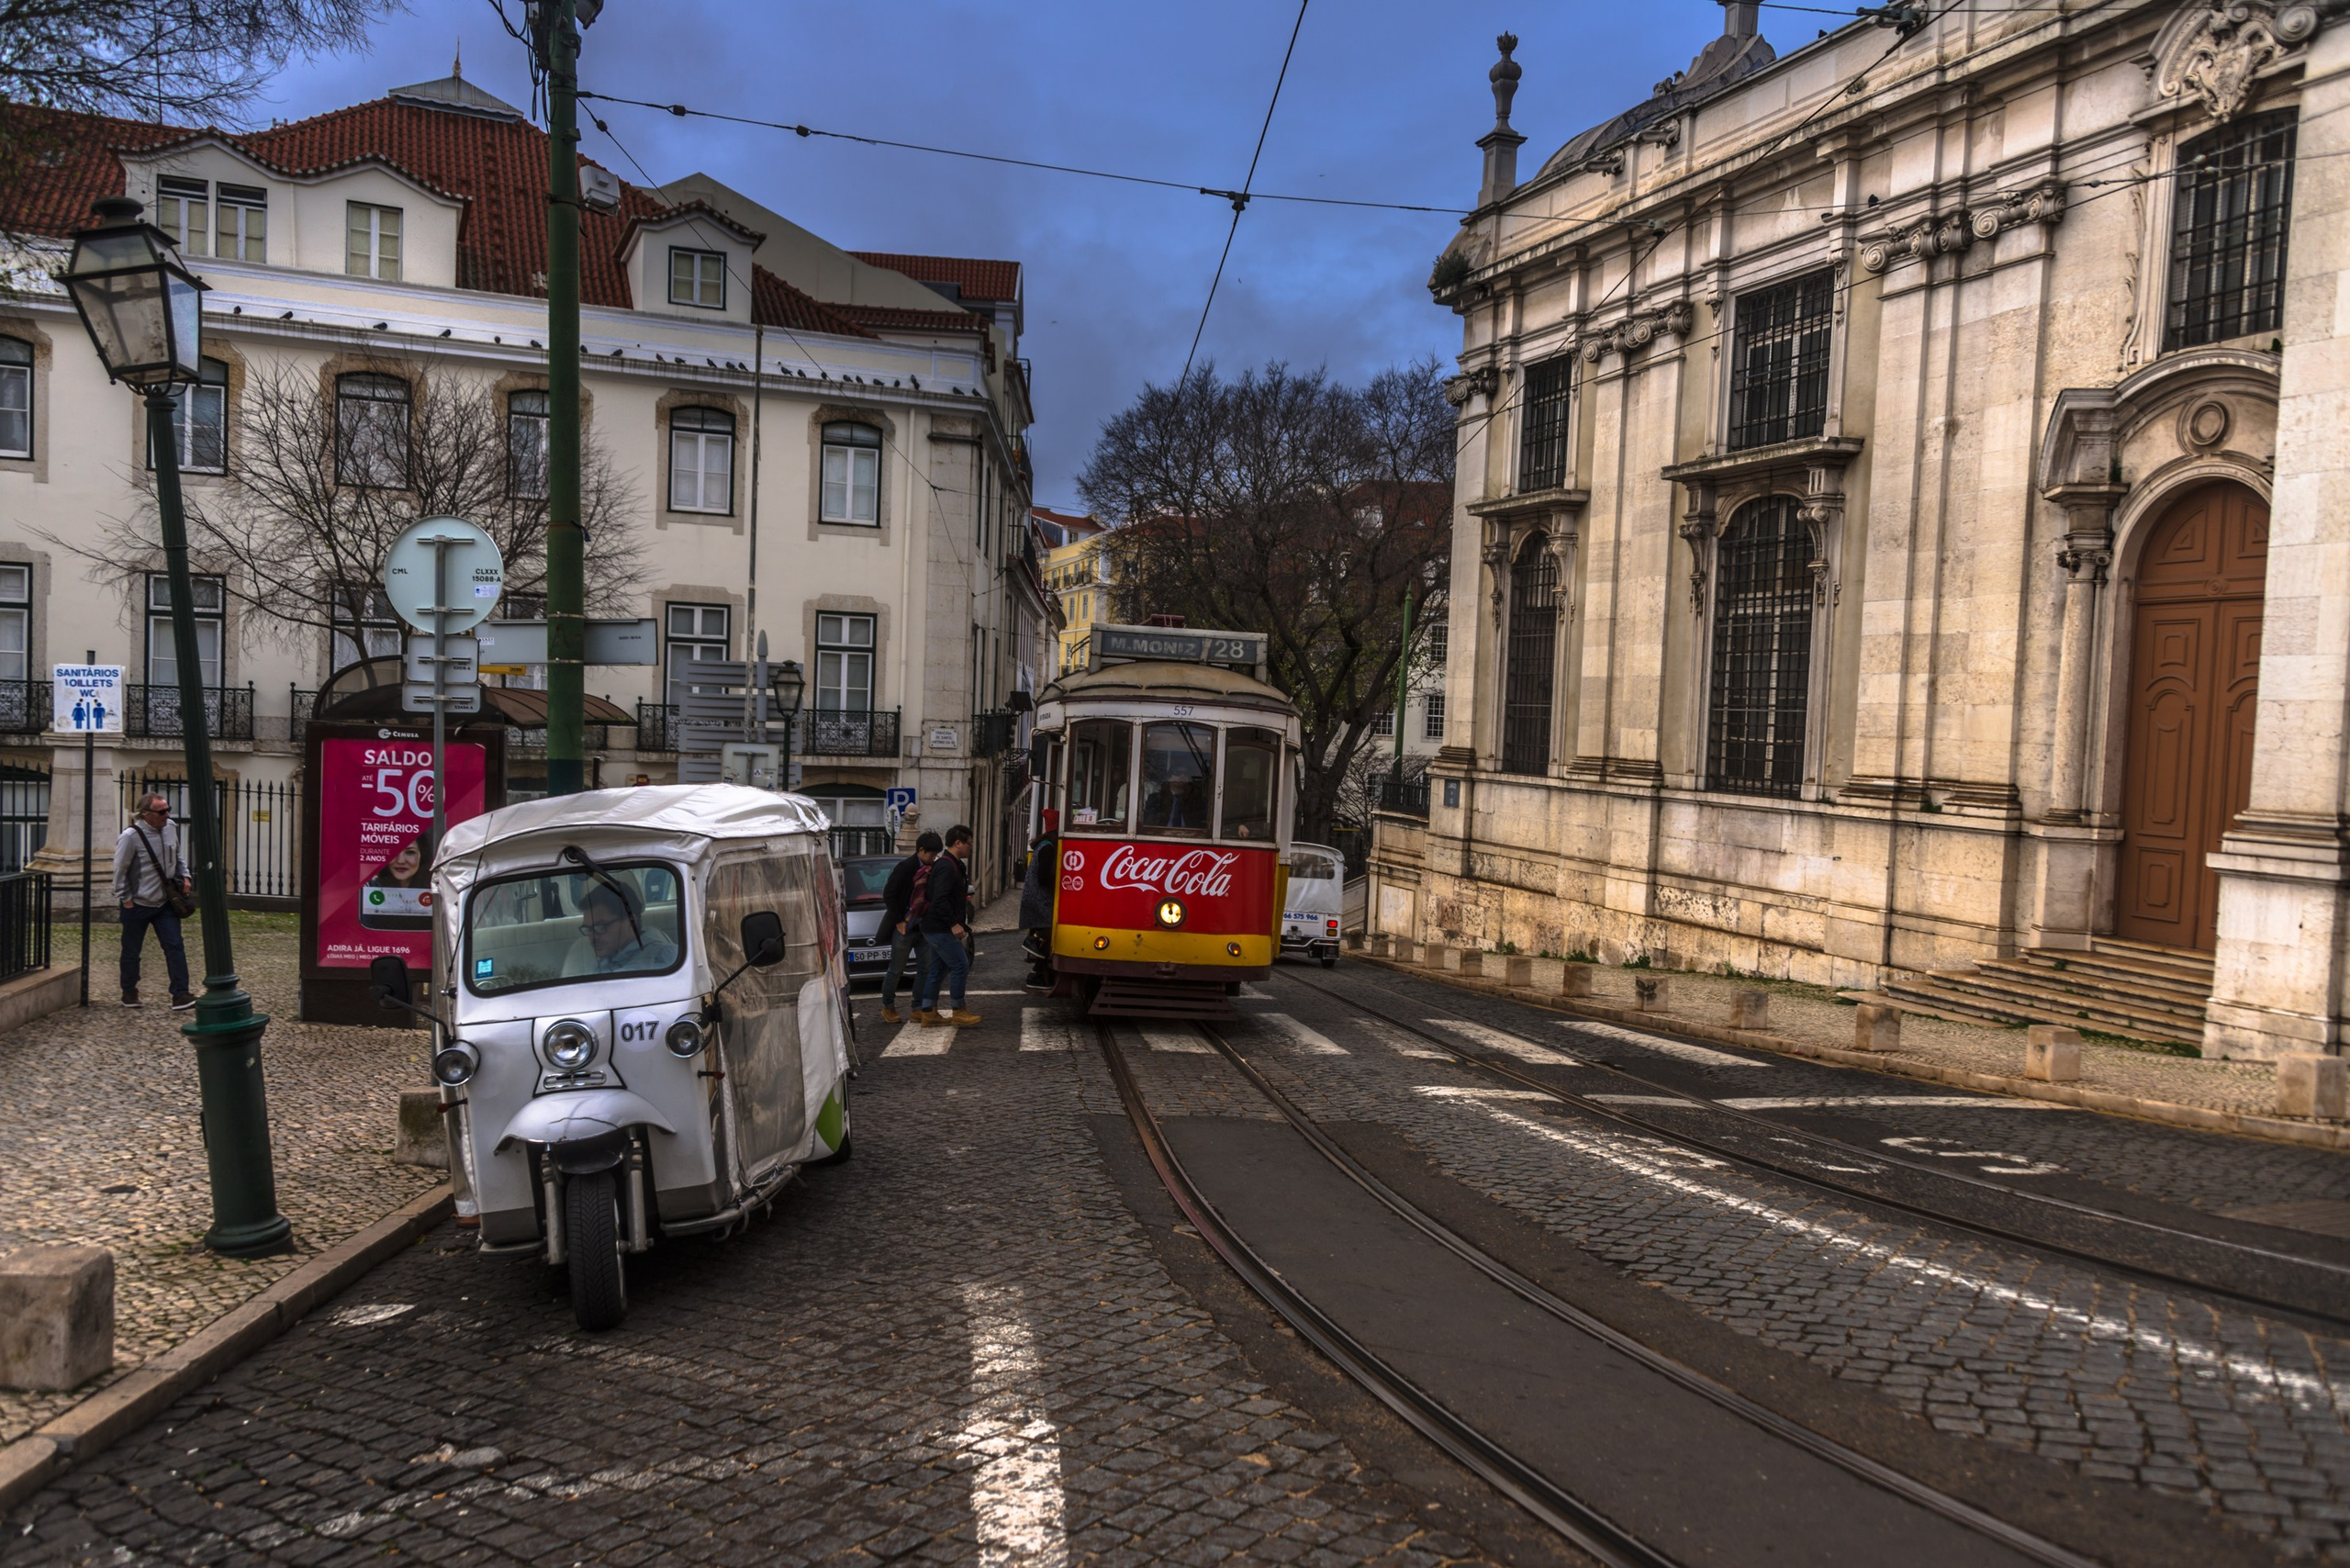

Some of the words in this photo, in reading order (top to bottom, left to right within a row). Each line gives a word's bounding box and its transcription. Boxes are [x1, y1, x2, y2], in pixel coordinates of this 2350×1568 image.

[1214, 639, 1244, 659] 28
[80, 689, 96, 698] WC
[1173, 705, 1194, 716] 557
[893, 790, 910, 806] P
[360, 821, 420, 834] TARIFÁRIOS
[361, 832, 400, 845] MÓVEIS
[360, 847, 390, 856] DURANTE
[1100, 845, 1240, 897] Coca-Cola
[621, 1020, 660, 1043] 017
